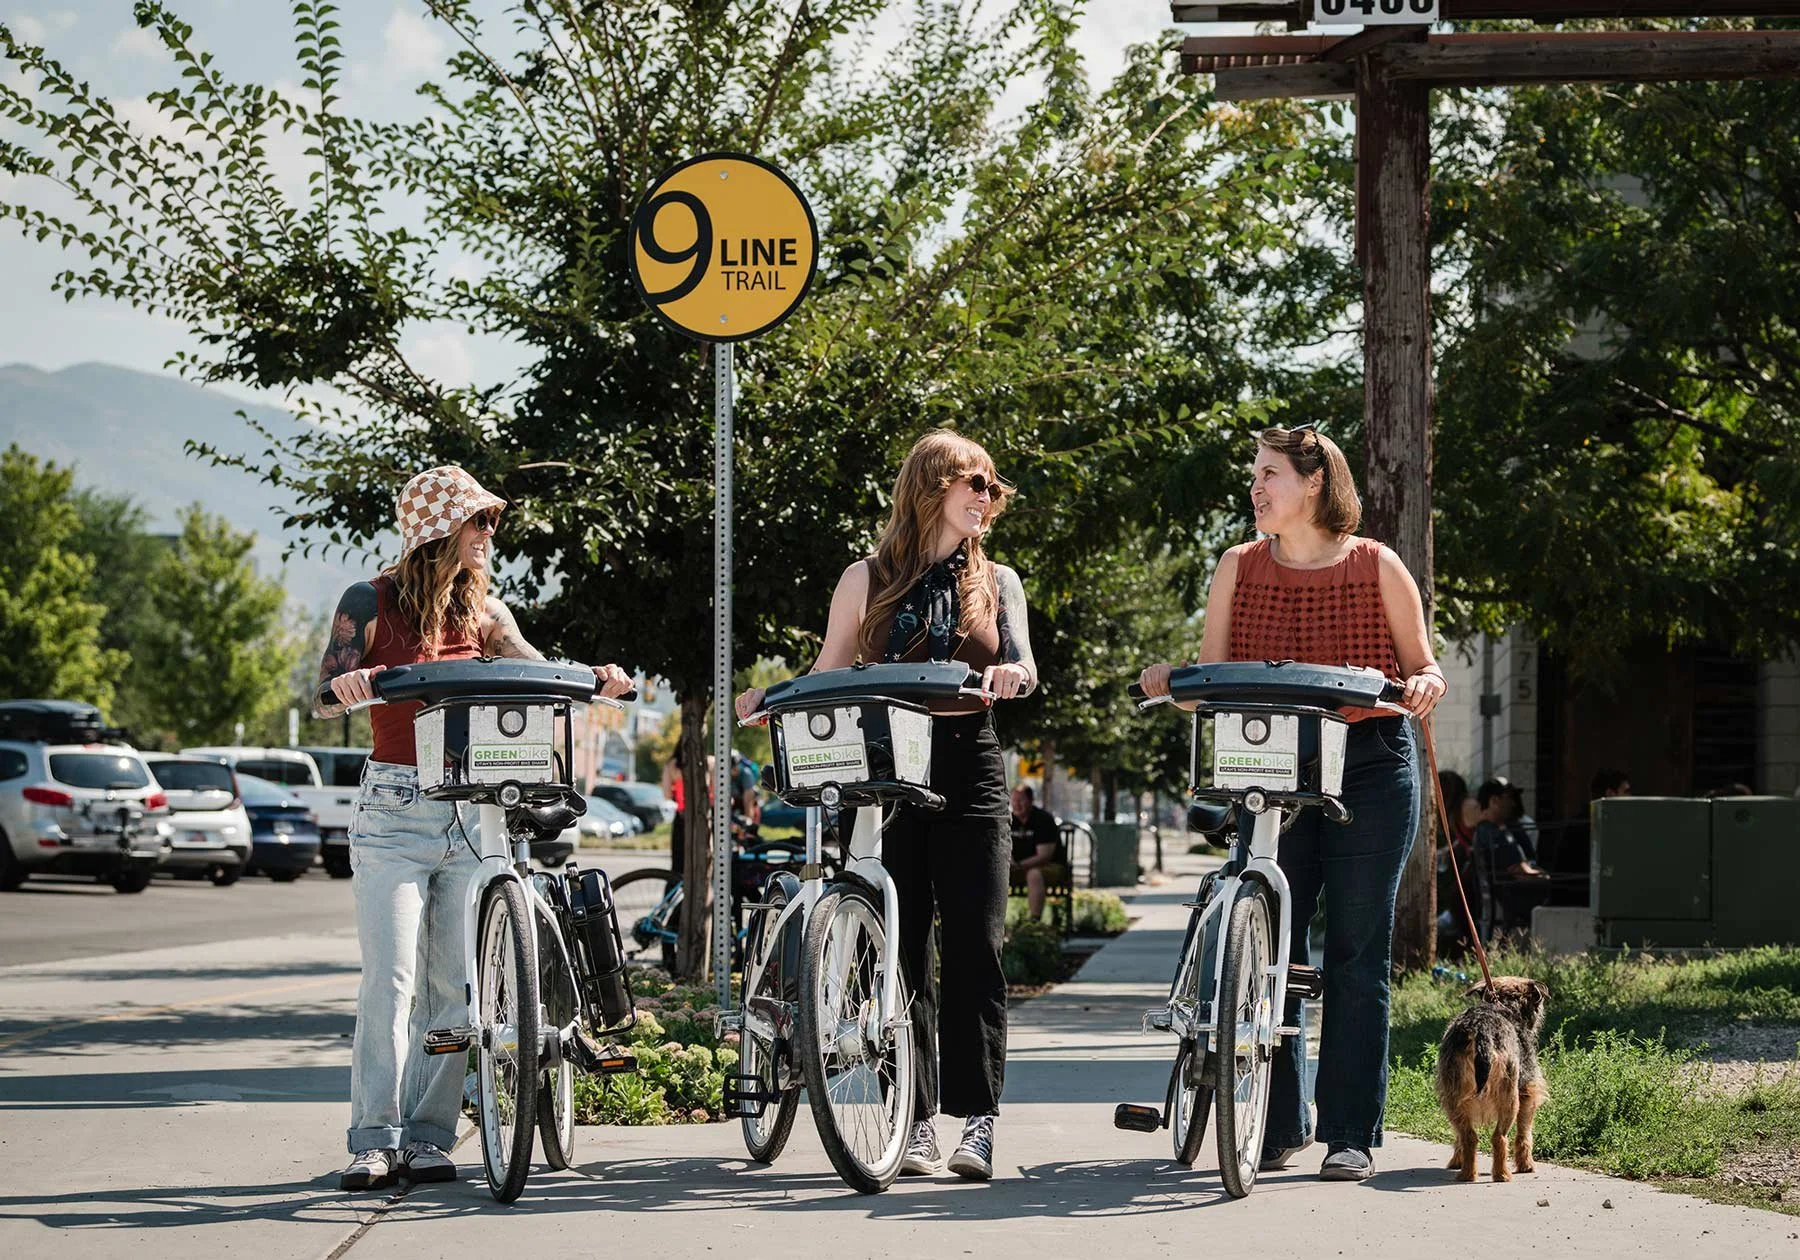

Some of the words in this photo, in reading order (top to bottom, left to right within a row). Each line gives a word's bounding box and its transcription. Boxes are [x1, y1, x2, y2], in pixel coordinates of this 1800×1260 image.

[637, 190, 713, 305] 9
[720, 238, 797, 266] LINE
[721, 271, 786, 290] TRAIL
